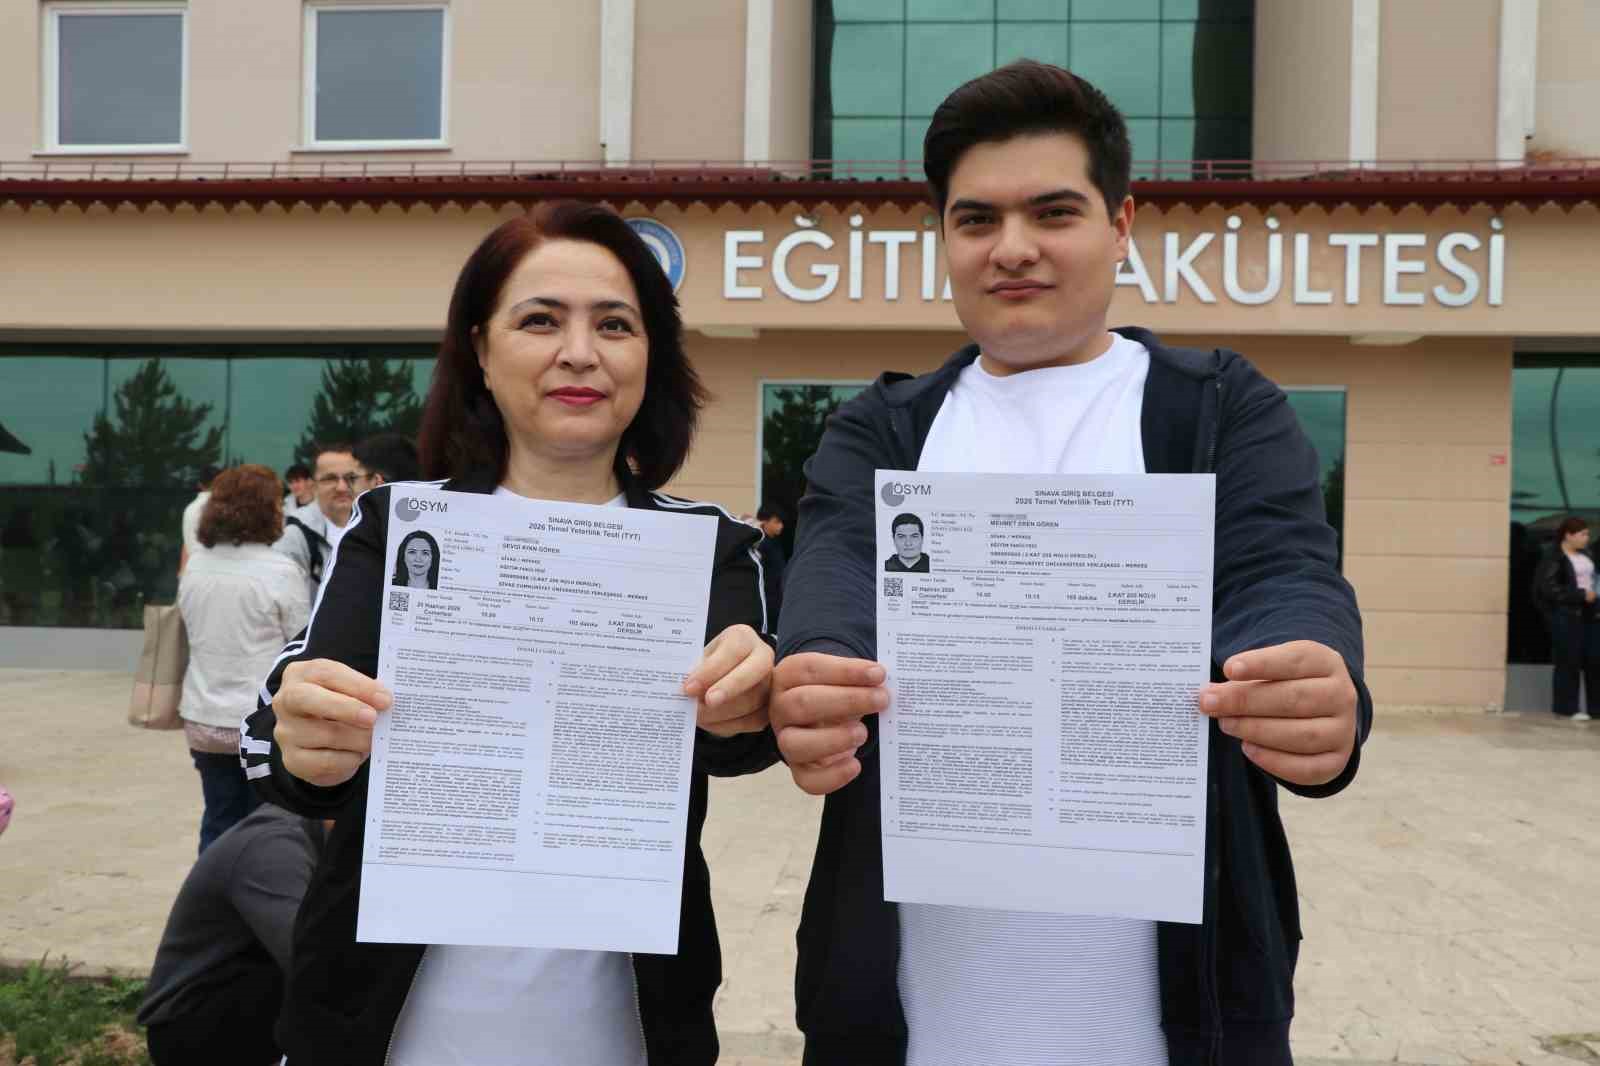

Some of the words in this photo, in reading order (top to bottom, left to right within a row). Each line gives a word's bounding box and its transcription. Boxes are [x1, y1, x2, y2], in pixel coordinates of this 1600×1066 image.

[723, 214, 953, 302] EĞİTİ
[894, 483, 932, 496] ÖSYM
[1061, 490, 1081, 498] GİRİŞ
[1082, 490, 1114, 498] BELGESİ
[408, 497, 448, 513] ÖSYM
[1034, 497, 1057, 505] Temel
[1113, 499, 1135, 507] (TYT)
[548, 516, 573, 525] SINAVA
[574, 519, 592, 528] GİRİŞ
[593, 521, 624, 531] BELGESİ
[547, 524, 569, 533] Temel
[570, 526, 601, 536] Yeterlilik
[603, 530, 620, 539] Testi
[621, 532, 641, 542] (TYT)
